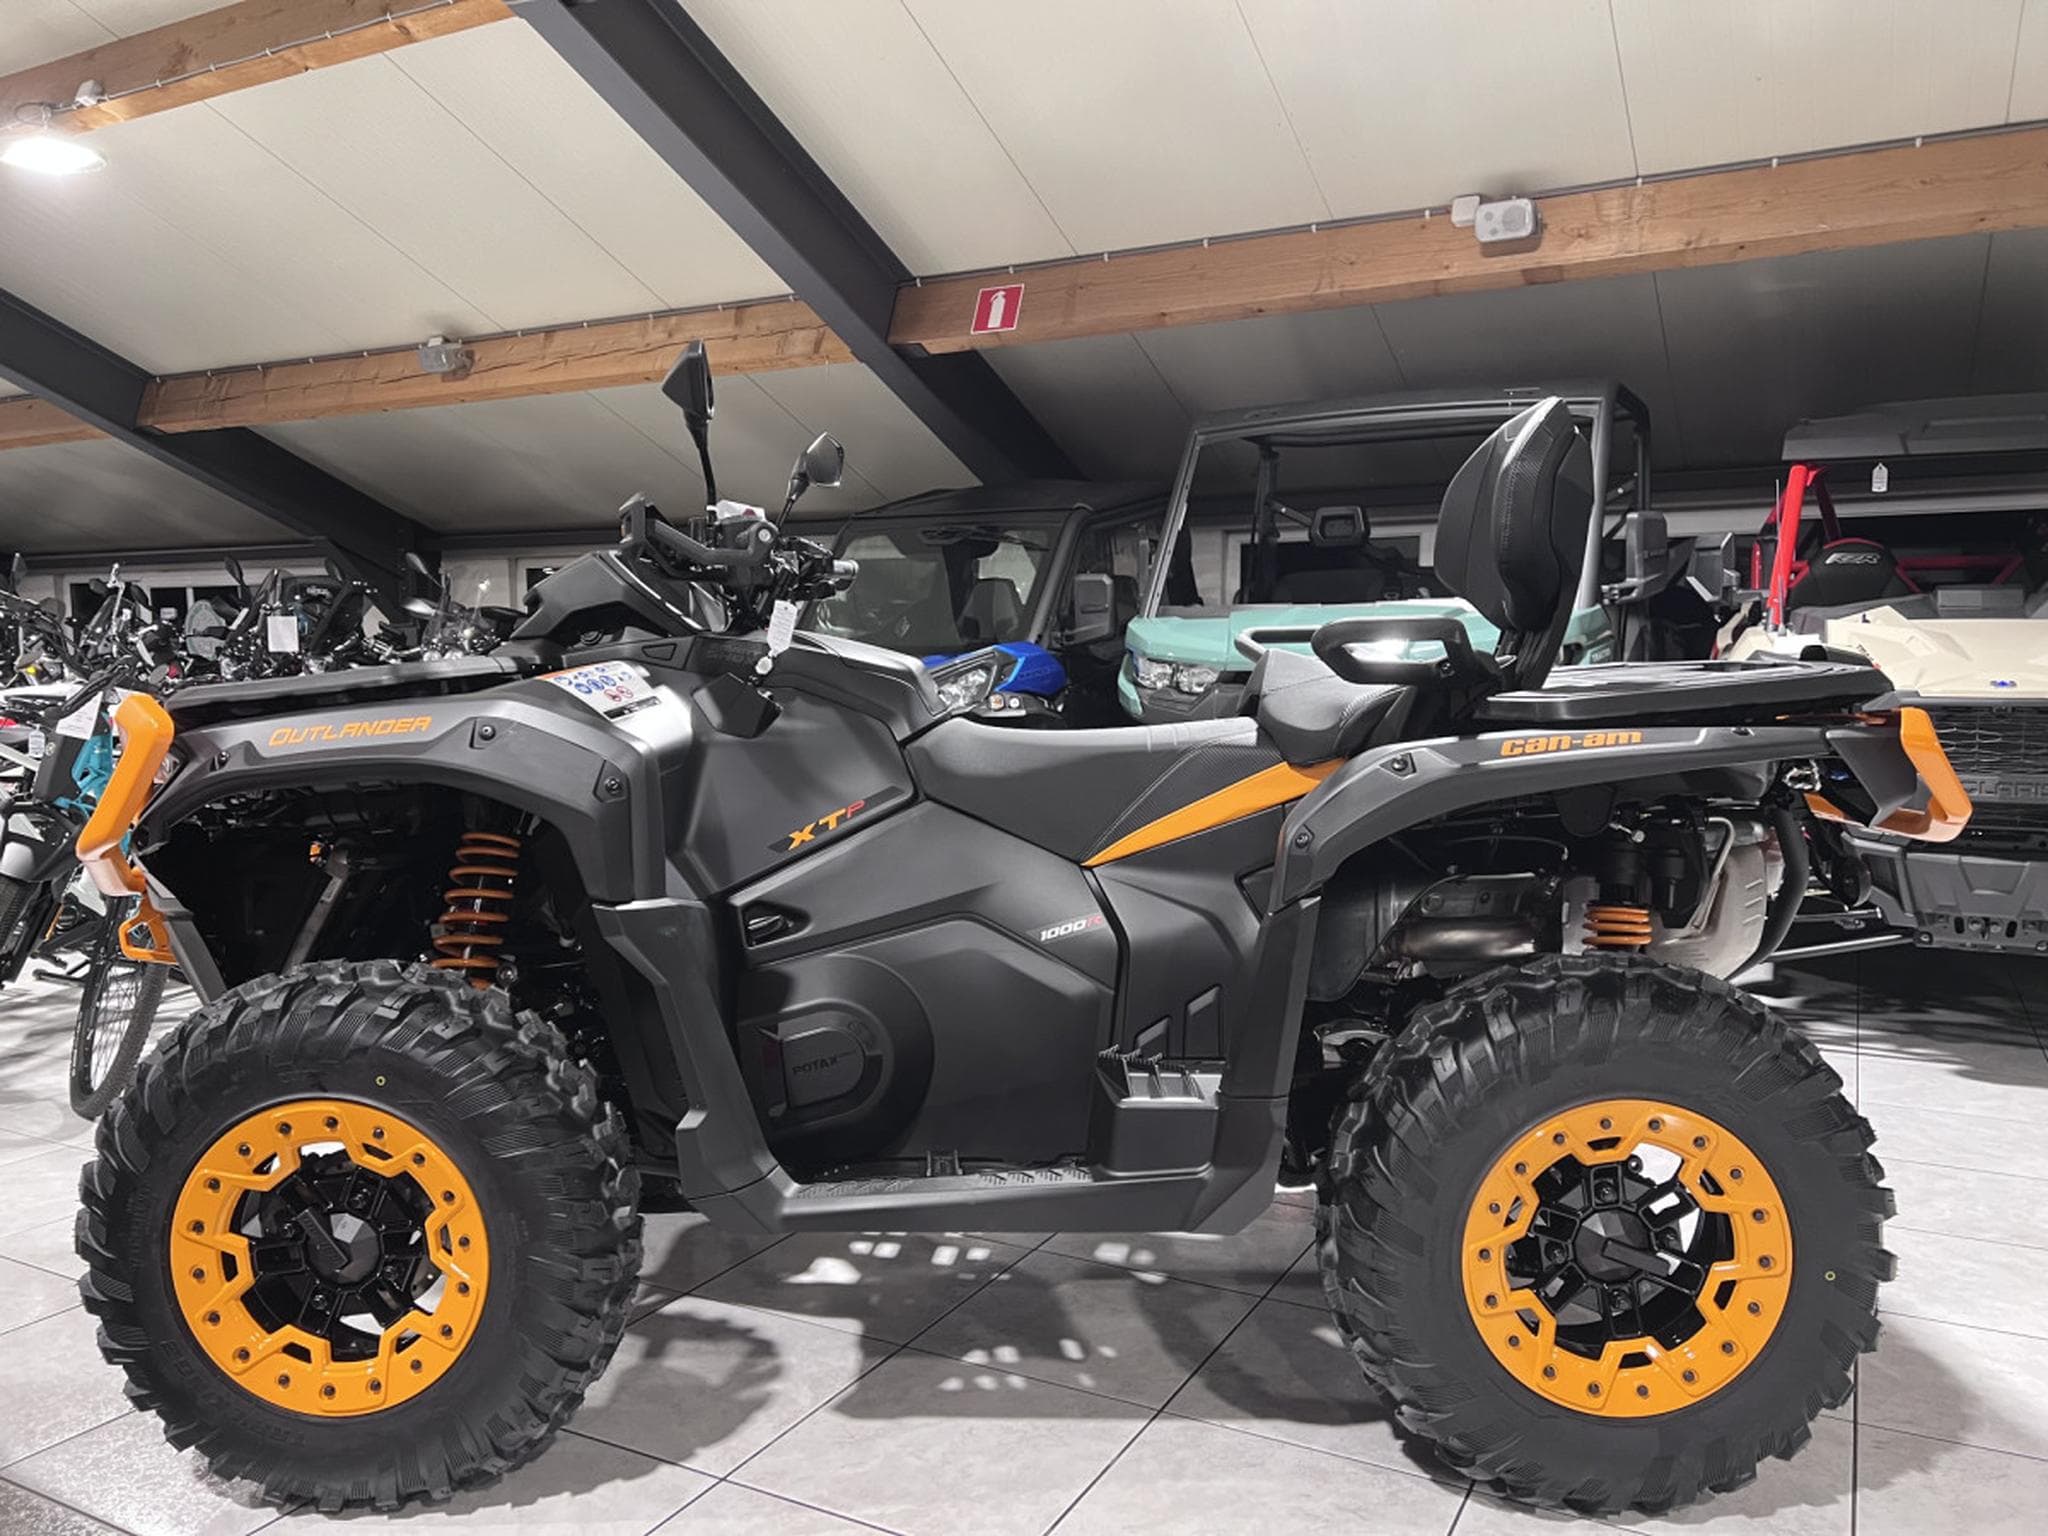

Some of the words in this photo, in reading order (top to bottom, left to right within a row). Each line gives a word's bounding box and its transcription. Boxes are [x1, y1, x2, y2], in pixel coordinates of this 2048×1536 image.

[268, 715, 432, 747] OUTLANDER
[1501, 730, 1642, 757] can-am
[787, 799, 866, 851] XTP
[792, 1055, 839, 1075] ROTAX
